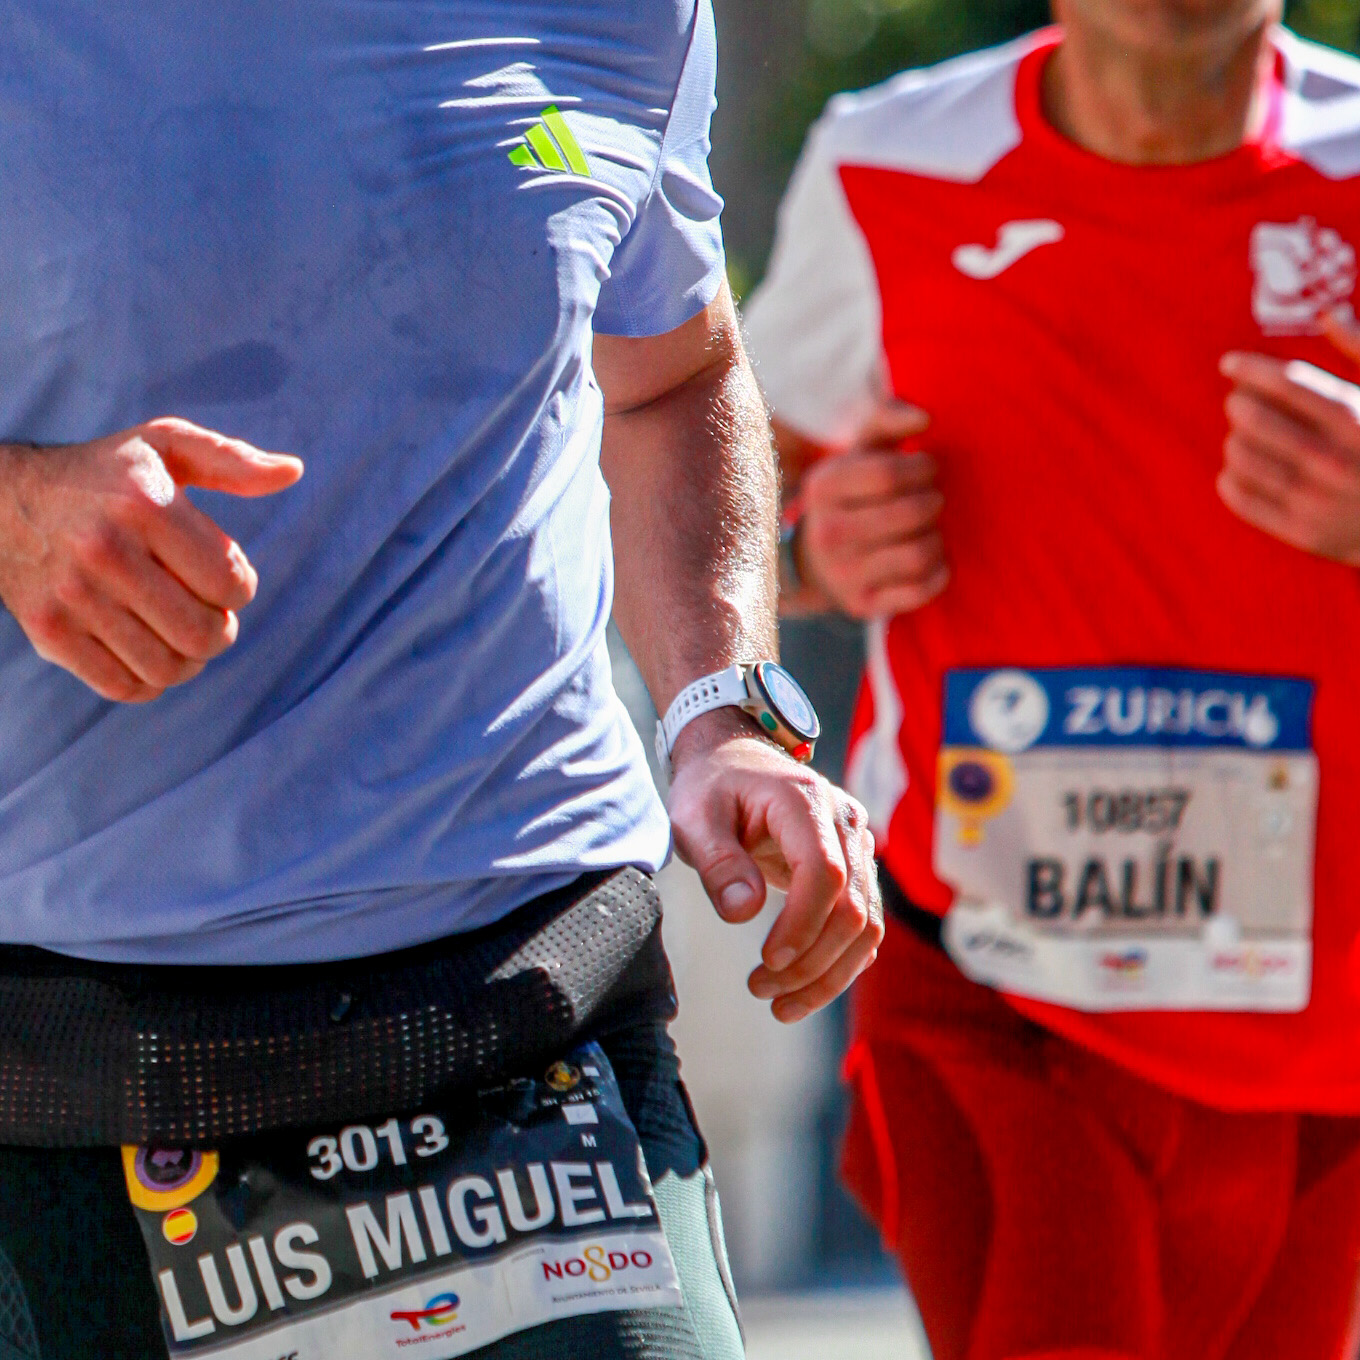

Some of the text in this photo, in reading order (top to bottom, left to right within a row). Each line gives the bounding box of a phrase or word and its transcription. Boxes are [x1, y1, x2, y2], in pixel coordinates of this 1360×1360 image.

[1061, 786, 1191, 833] 10857
[1024, 843, 1220, 920] BALÍN
[307, 1114, 449, 1180] 3013
[581, 1133, 597, 1147] M
[158, 1160, 654, 1342] LUIS MIGUEL
